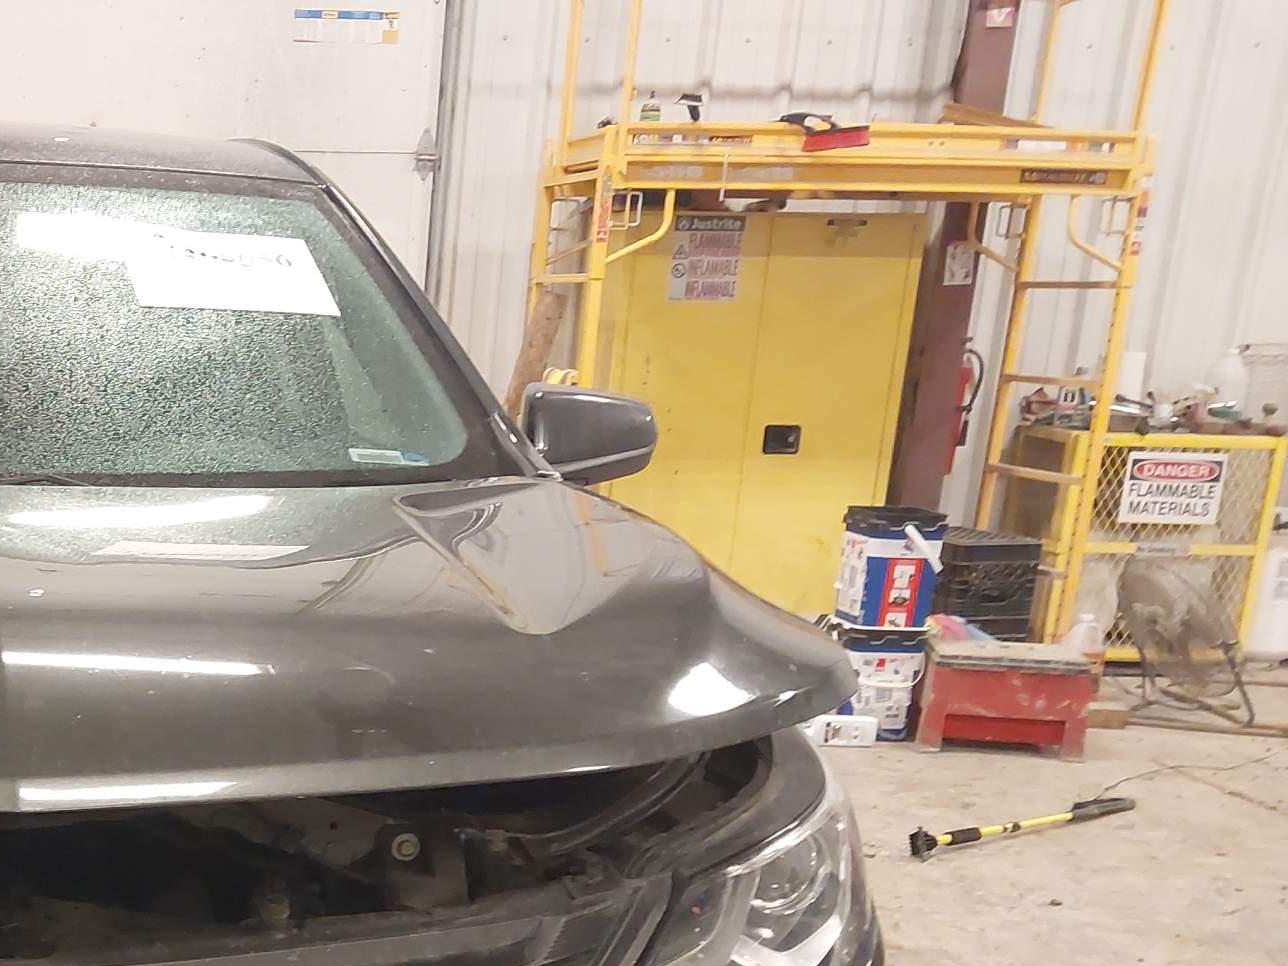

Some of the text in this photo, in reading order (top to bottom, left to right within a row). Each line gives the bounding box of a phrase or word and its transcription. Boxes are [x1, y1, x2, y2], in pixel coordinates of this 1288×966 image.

[1142, 463, 1210, 477] DANGER
[1128, 482, 1217, 499] FLAMMABLE
[1127, 501, 1210, 517] MATERIALS
